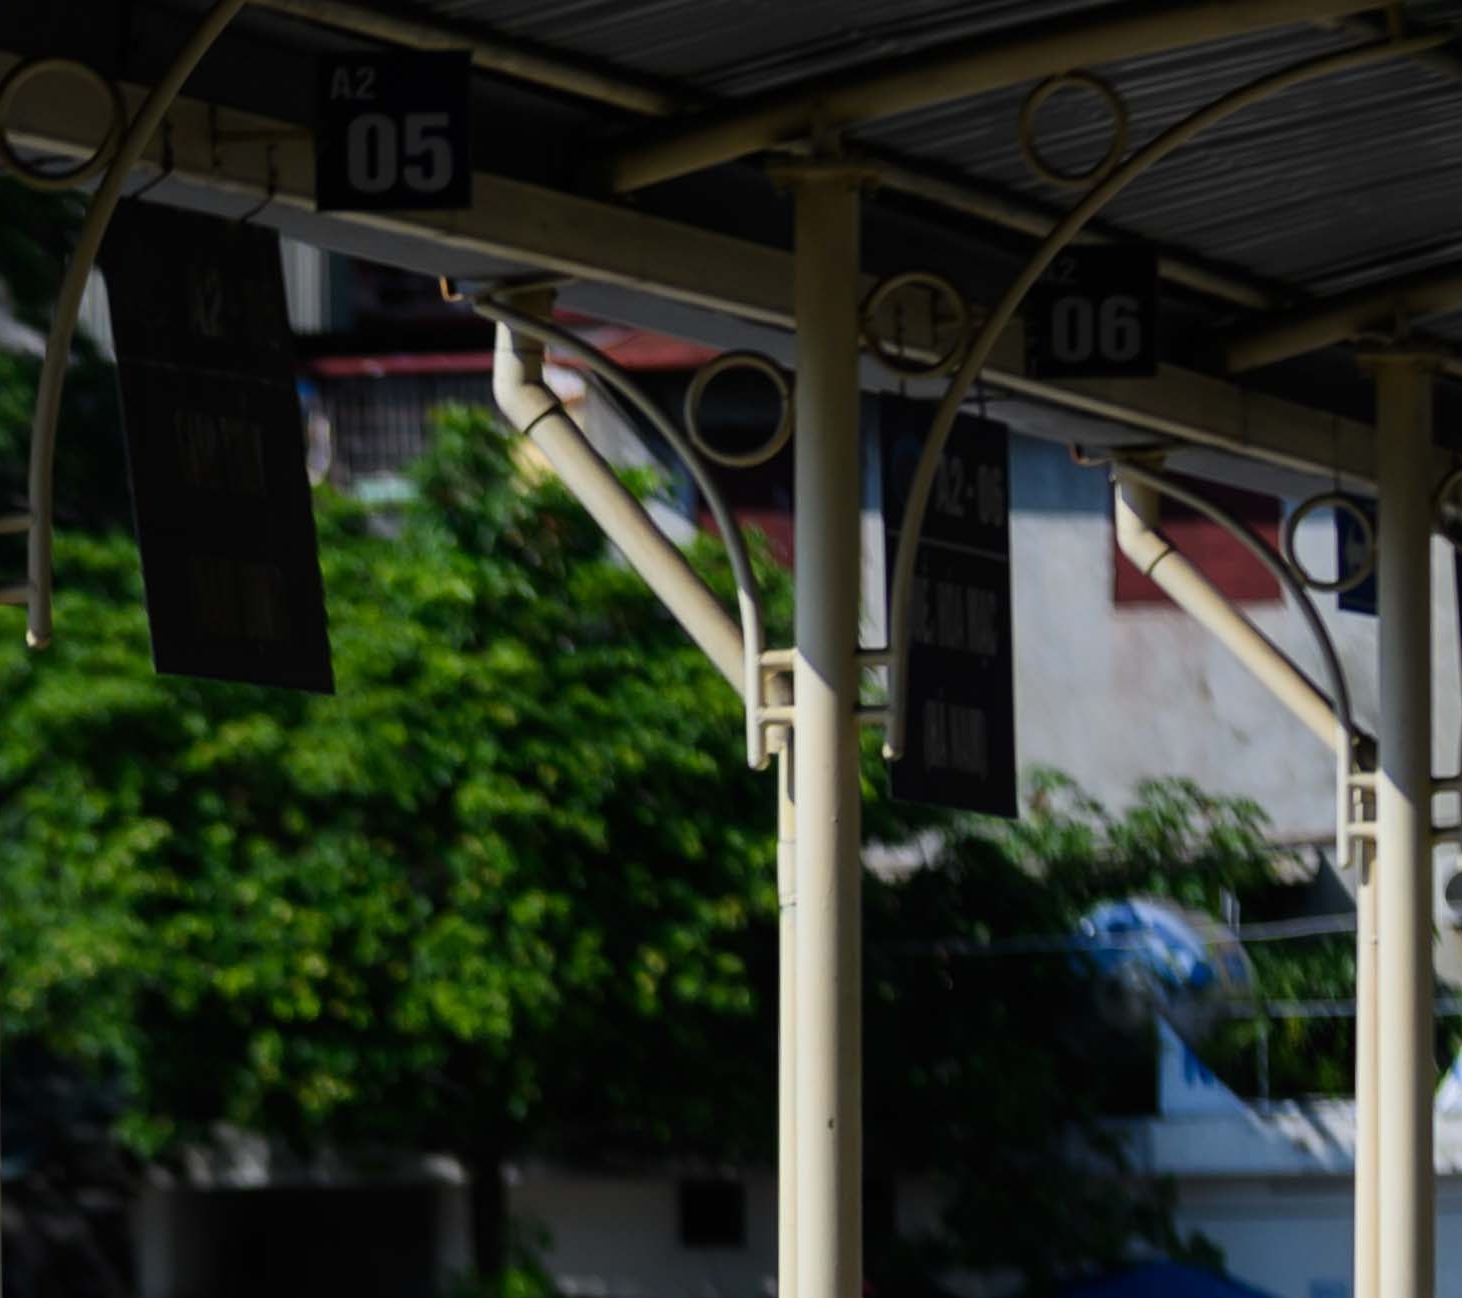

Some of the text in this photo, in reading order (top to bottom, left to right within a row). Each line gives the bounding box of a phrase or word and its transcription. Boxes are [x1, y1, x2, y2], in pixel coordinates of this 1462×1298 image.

[329, 63, 378, 101] A2
[345, 111, 456, 194] 05
[1051, 293, 1142, 364] 06
